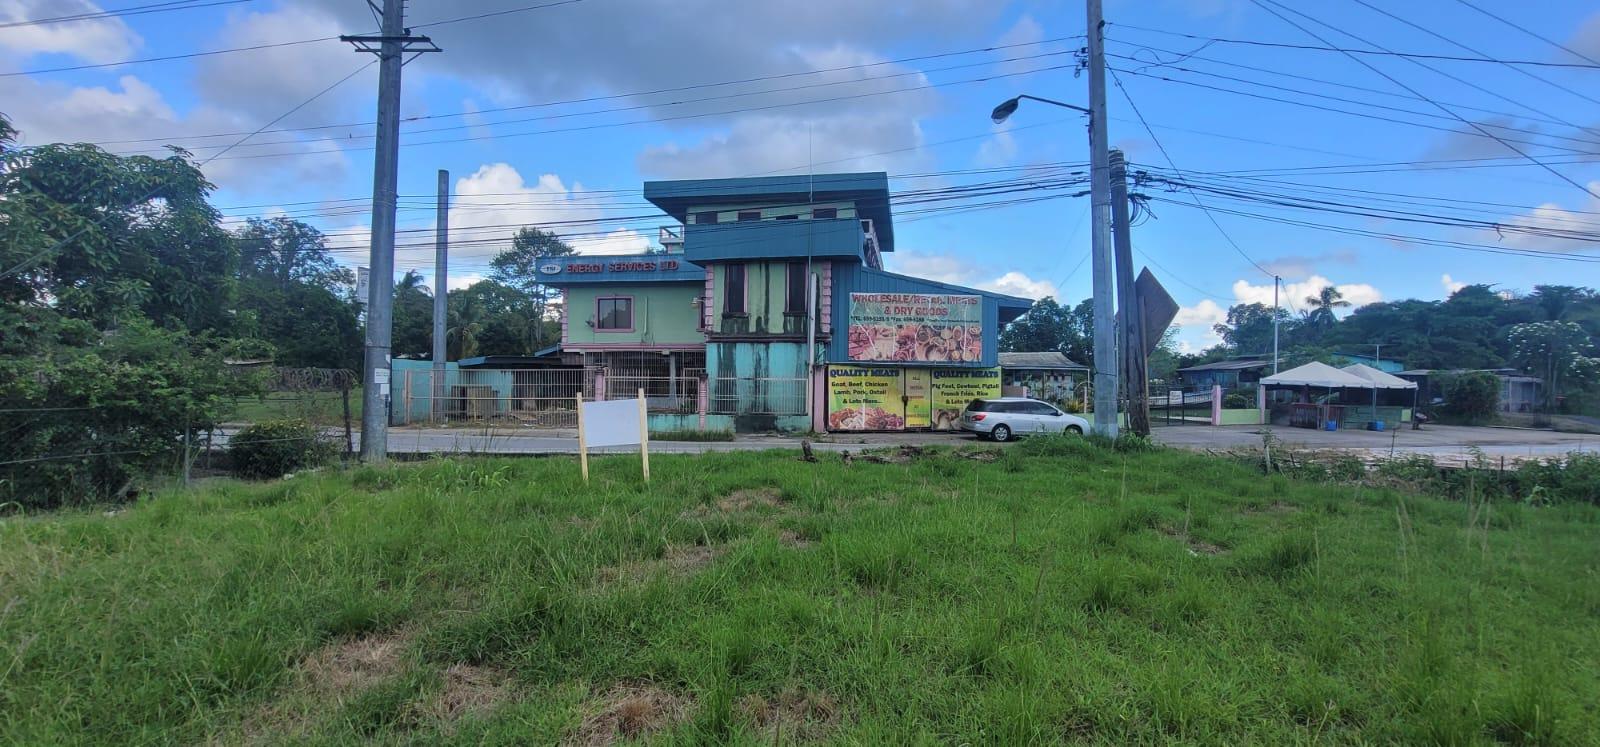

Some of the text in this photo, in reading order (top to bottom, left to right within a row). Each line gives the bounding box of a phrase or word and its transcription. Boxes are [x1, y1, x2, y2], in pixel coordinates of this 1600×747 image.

[566, 260, 679, 273] ENERGY SERVICES LTD
[884, 306, 949, 317] & DRY GOODS
[829, 369, 868, 377] QUALITY
[933, 371, 970, 379] QUALITY
